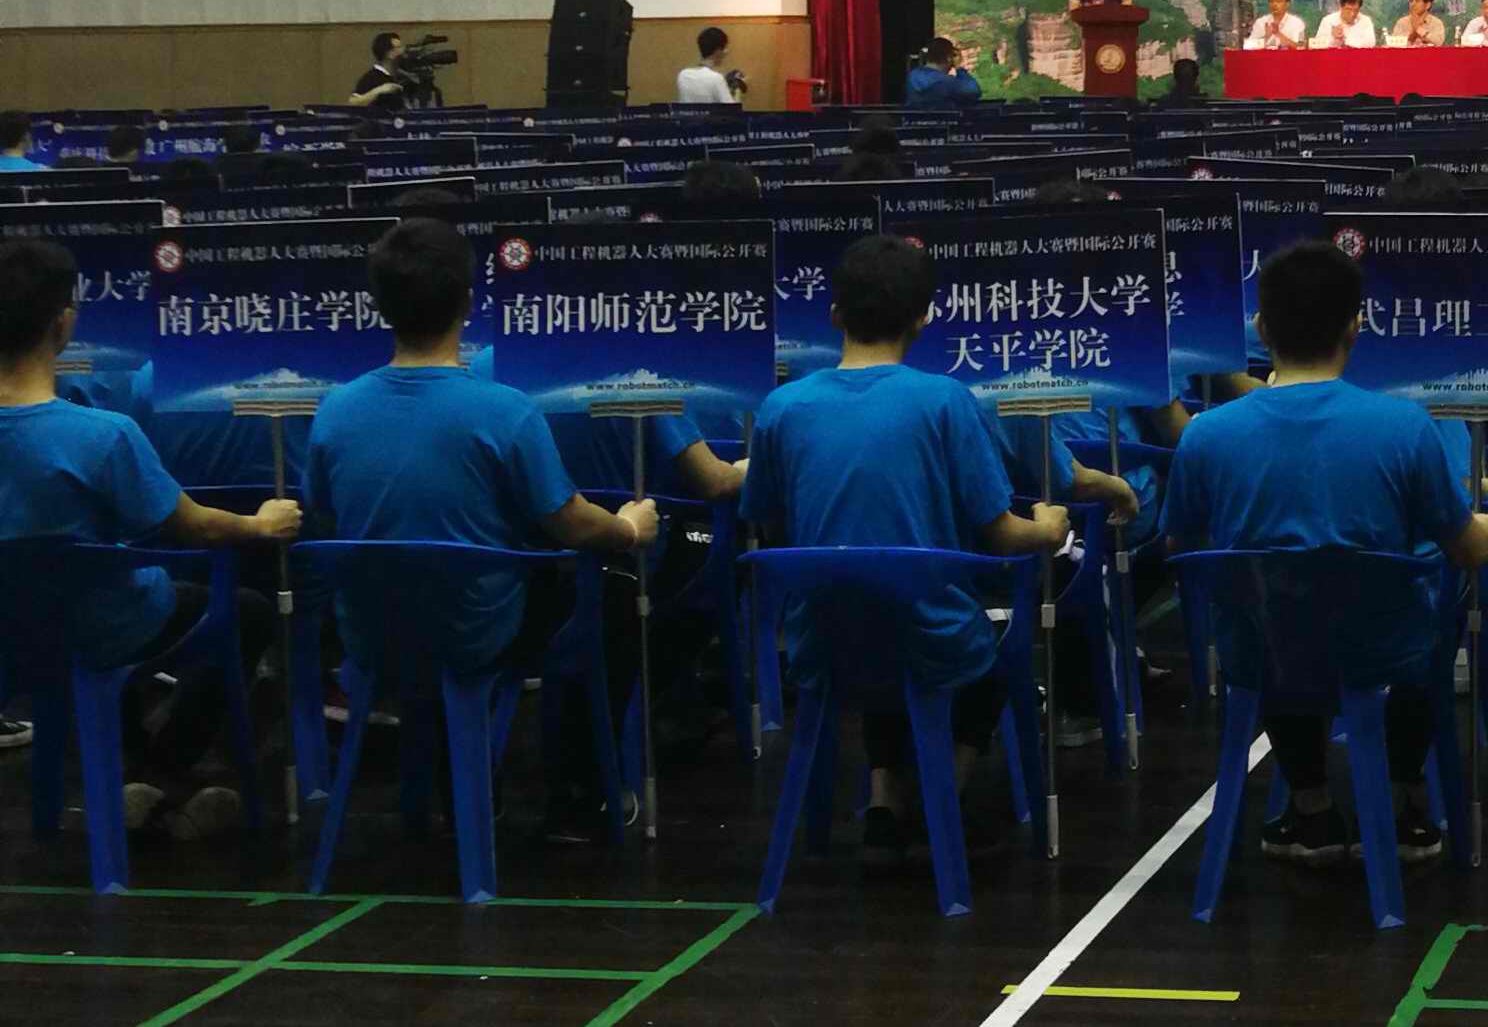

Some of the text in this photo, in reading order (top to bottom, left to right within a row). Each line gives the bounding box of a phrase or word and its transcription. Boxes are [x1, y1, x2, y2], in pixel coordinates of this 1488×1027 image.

[535, 242, 769, 261] 中国工程机器人大赛暨国际公开赛
[928, 233, 1158, 261] 中国工程机器人大赛暨国际公开赛
[157, 289, 394, 337] 南京晓庄学院
[501, 290, 768, 336] 南阳师范学院
[945, 327, 1112, 374] 天平学院
